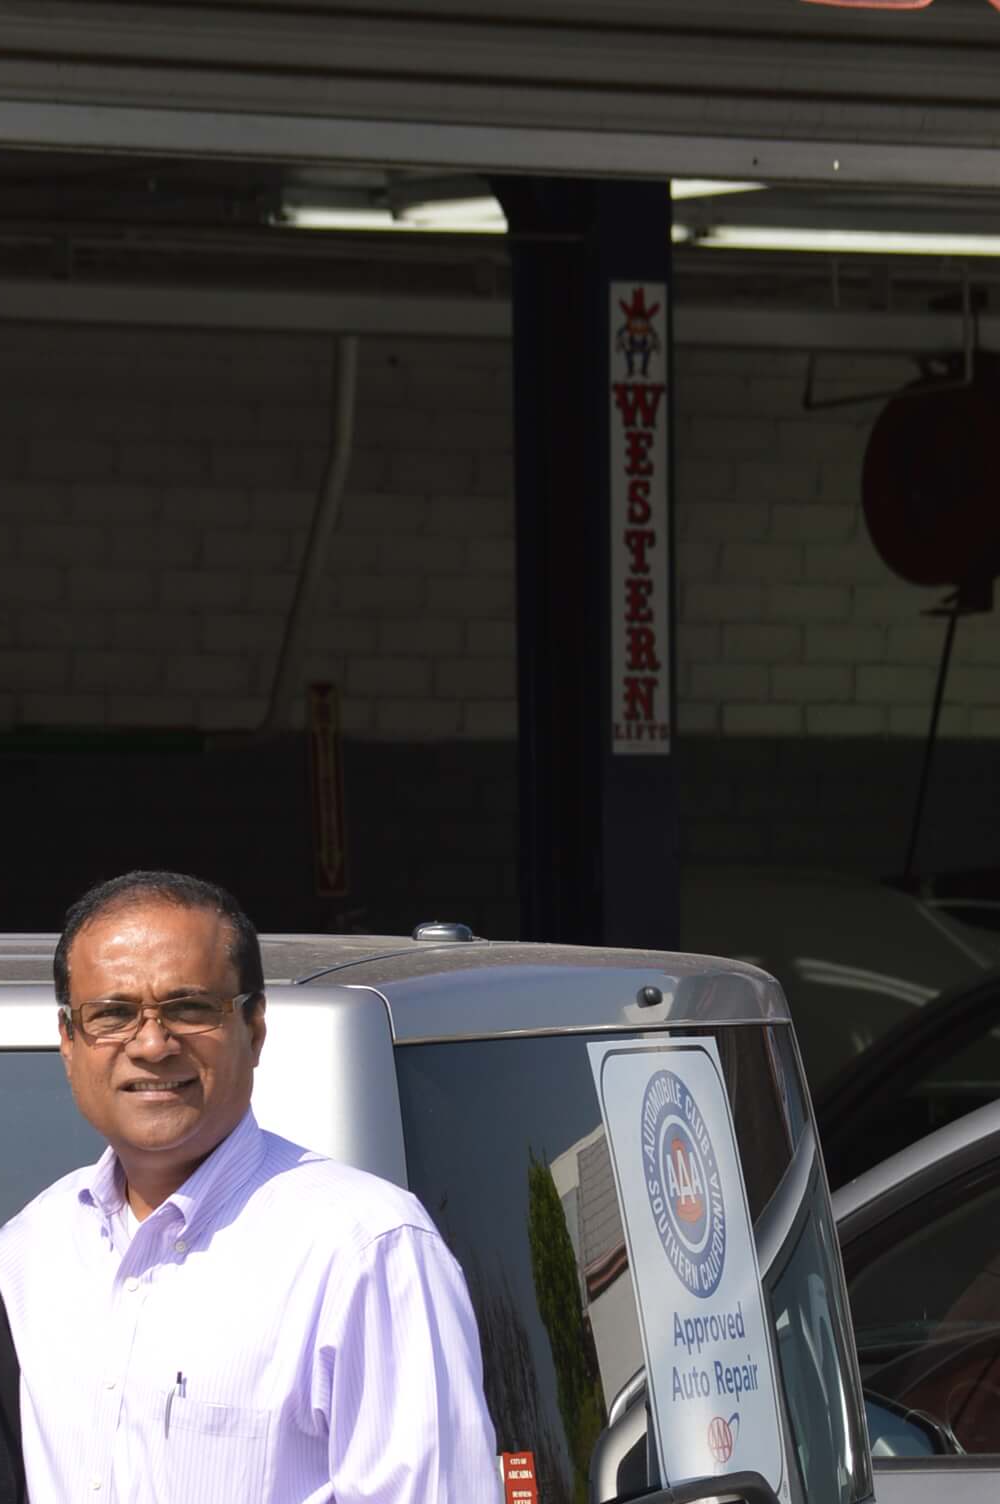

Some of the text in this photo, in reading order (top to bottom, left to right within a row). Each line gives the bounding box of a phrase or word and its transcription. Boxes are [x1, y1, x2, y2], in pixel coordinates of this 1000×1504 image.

[612, 382, 665, 721] WESTERN
[644, 1078, 710, 1164] AUTOMOBILE CLUB
[665, 1149, 704, 1206] AAA
[648, 1171, 725, 1291] SOUTHERN CALIFORNIA
[673, 1301, 746, 1355] Approved
[672, 1354, 759, 1403] Auto Repair
